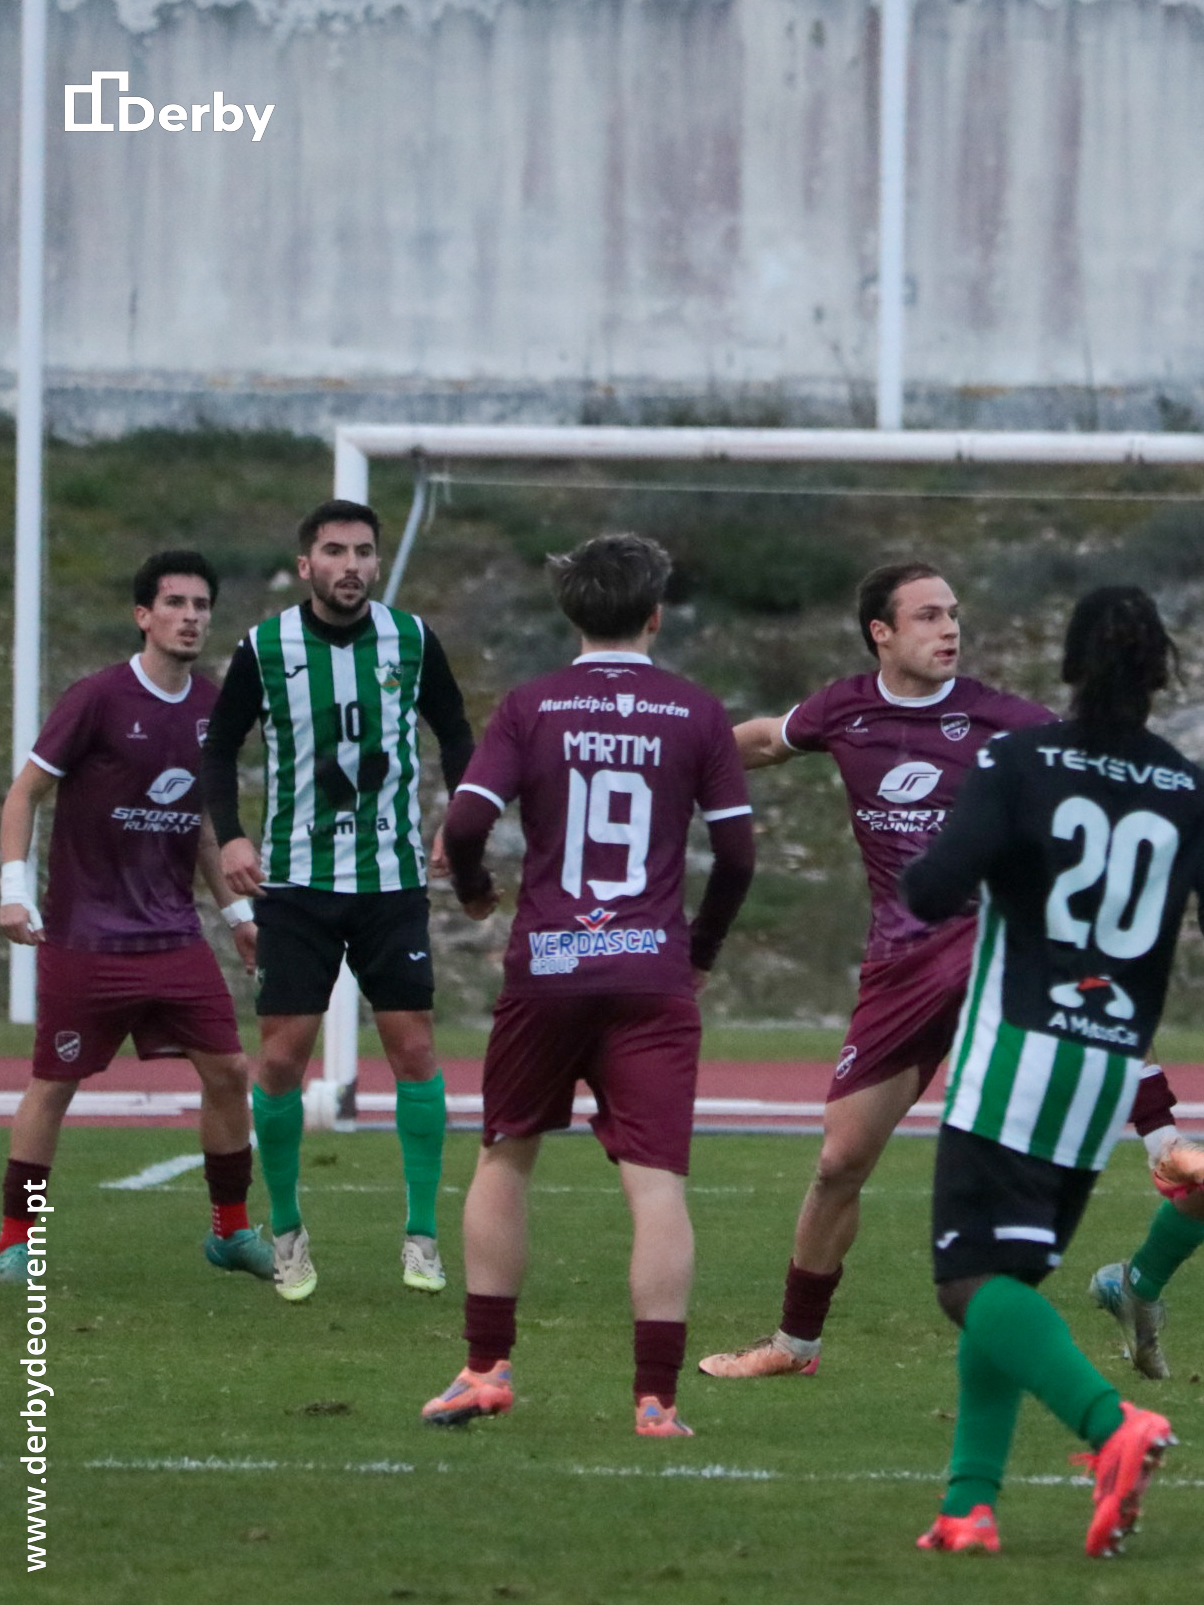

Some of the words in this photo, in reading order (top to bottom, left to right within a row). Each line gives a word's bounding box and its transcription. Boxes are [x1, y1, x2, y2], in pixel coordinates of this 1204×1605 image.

[538, 695, 616, 714] Município
[635, 700, 690, 718] Ourém
[334, 700, 364, 743] 10
[563, 730, 662, 767] MARTIM
[111, 806, 202, 826] SPORTS
[856, 809, 947, 822] SPORT
[869, 820, 943, 833] RUNWA
[561, 767, 653, 901] 19
[1045, 795, 1180, 960] 20
[528, 929, 660, 958] VERDASCA
[529, 957, 580, 976] GROUP
